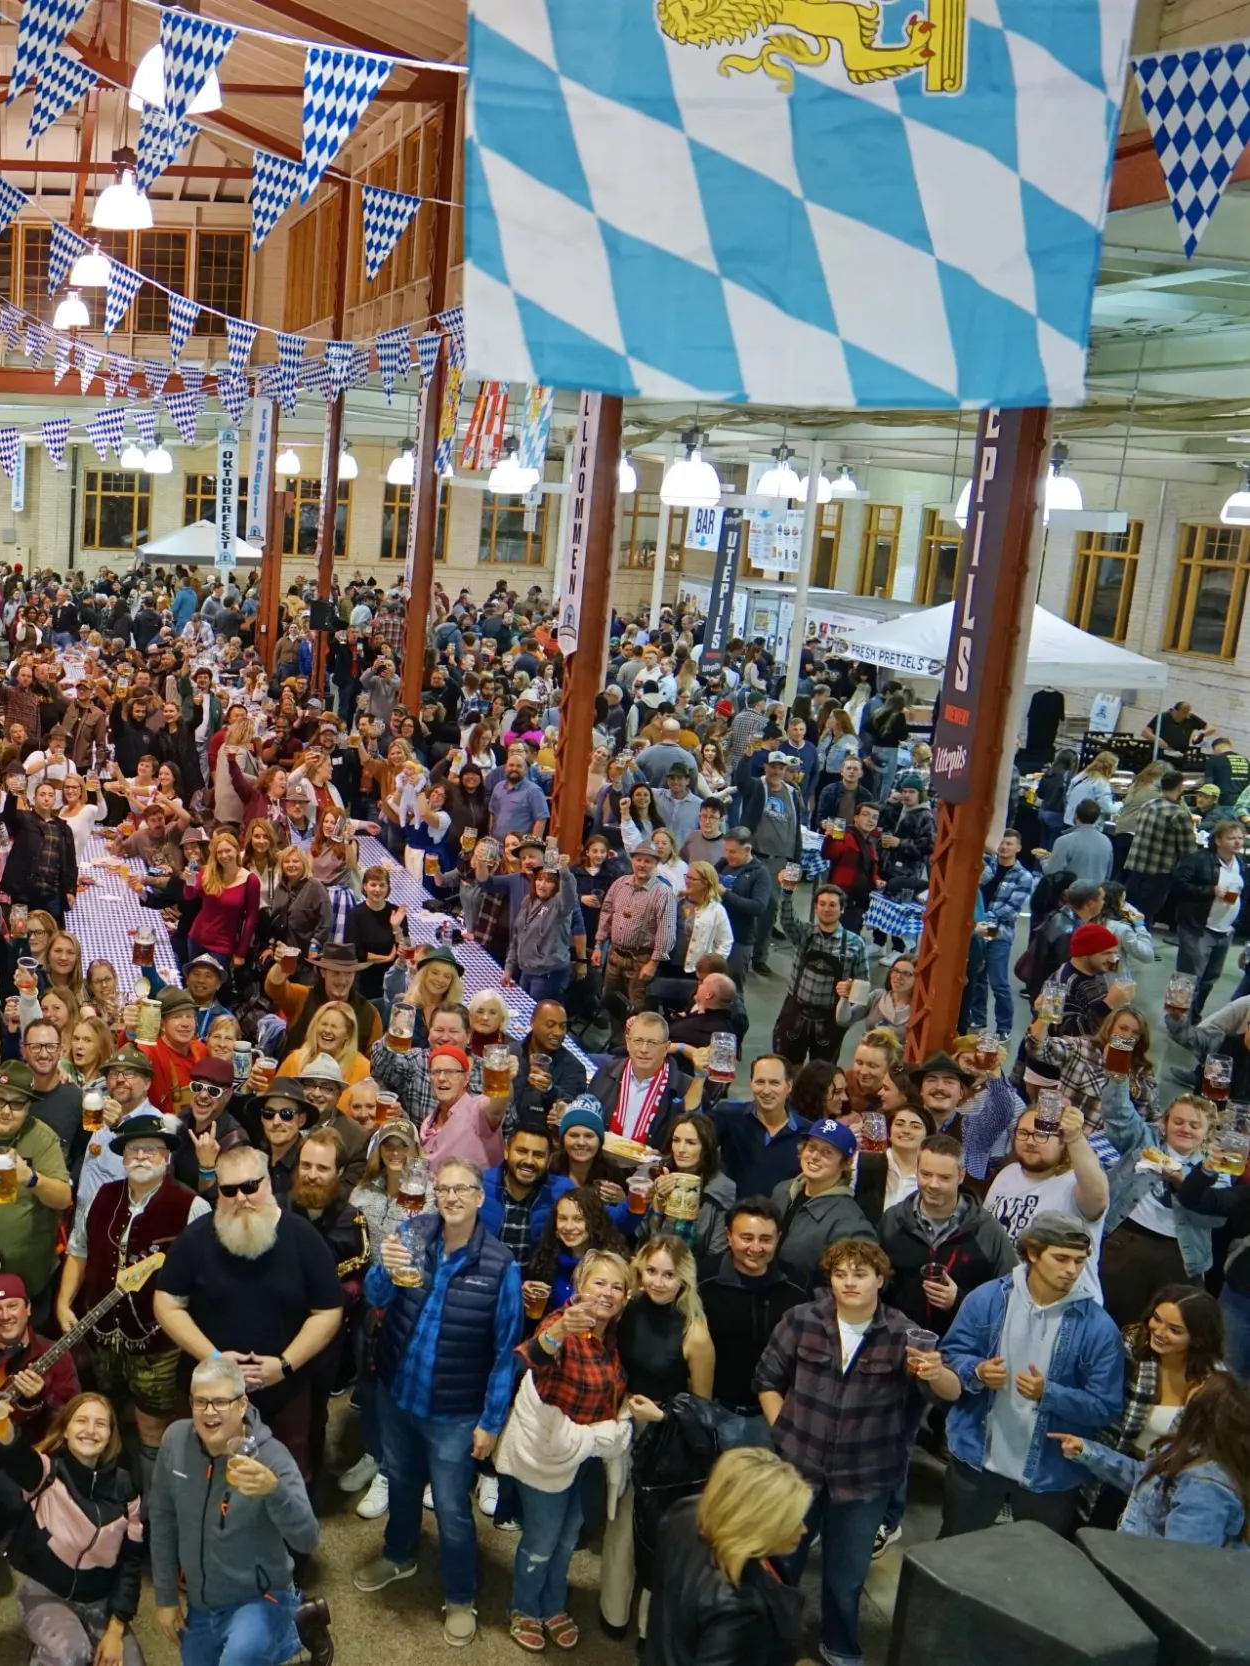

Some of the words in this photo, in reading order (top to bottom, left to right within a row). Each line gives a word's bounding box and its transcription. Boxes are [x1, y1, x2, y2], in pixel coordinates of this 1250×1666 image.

[258, 408, 268, 443] EIN
[221, 450, 234, 549] OKTOBERFEST
[252, 449, 264, 518] PROSIT
[568, 394, 590, 596] LLKOMMEN
[695, 508, 716, 535] BAR
[954, 408, 1001, 692] EPILS
[711, 531, 738, 650] UTEPILS
[851, 643, 876, 660] FRESH
[879, 653, 925, 671] PRETZELS
[934, 744, 967, 779] Utepils
